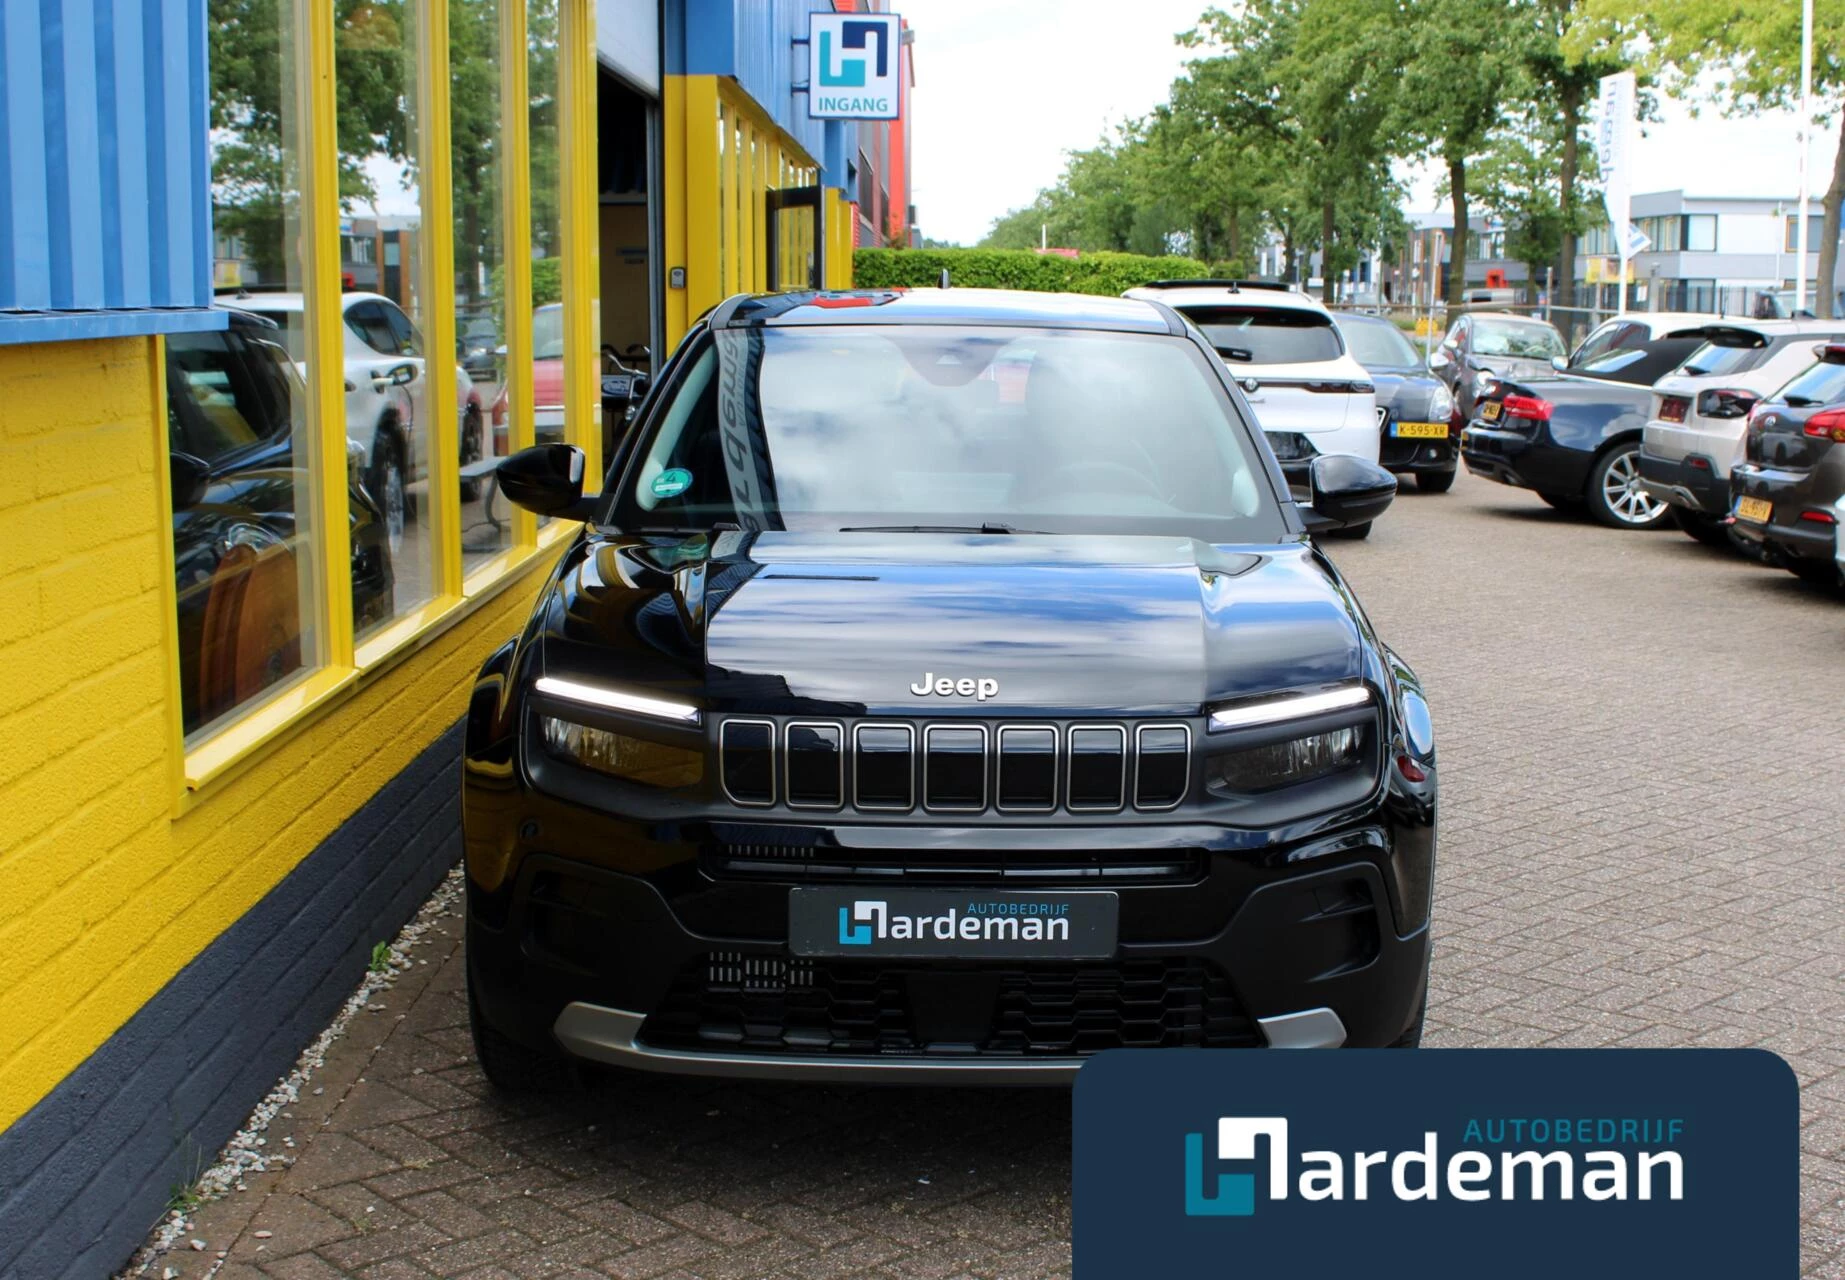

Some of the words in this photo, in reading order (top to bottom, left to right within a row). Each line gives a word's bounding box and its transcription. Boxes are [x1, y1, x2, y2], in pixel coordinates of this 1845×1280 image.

[819, 97, 888, 112] INGANG
[910, 672, 998, 702] Jeep
[967, 903, 1070, 915] AUTOBEDRIJF
